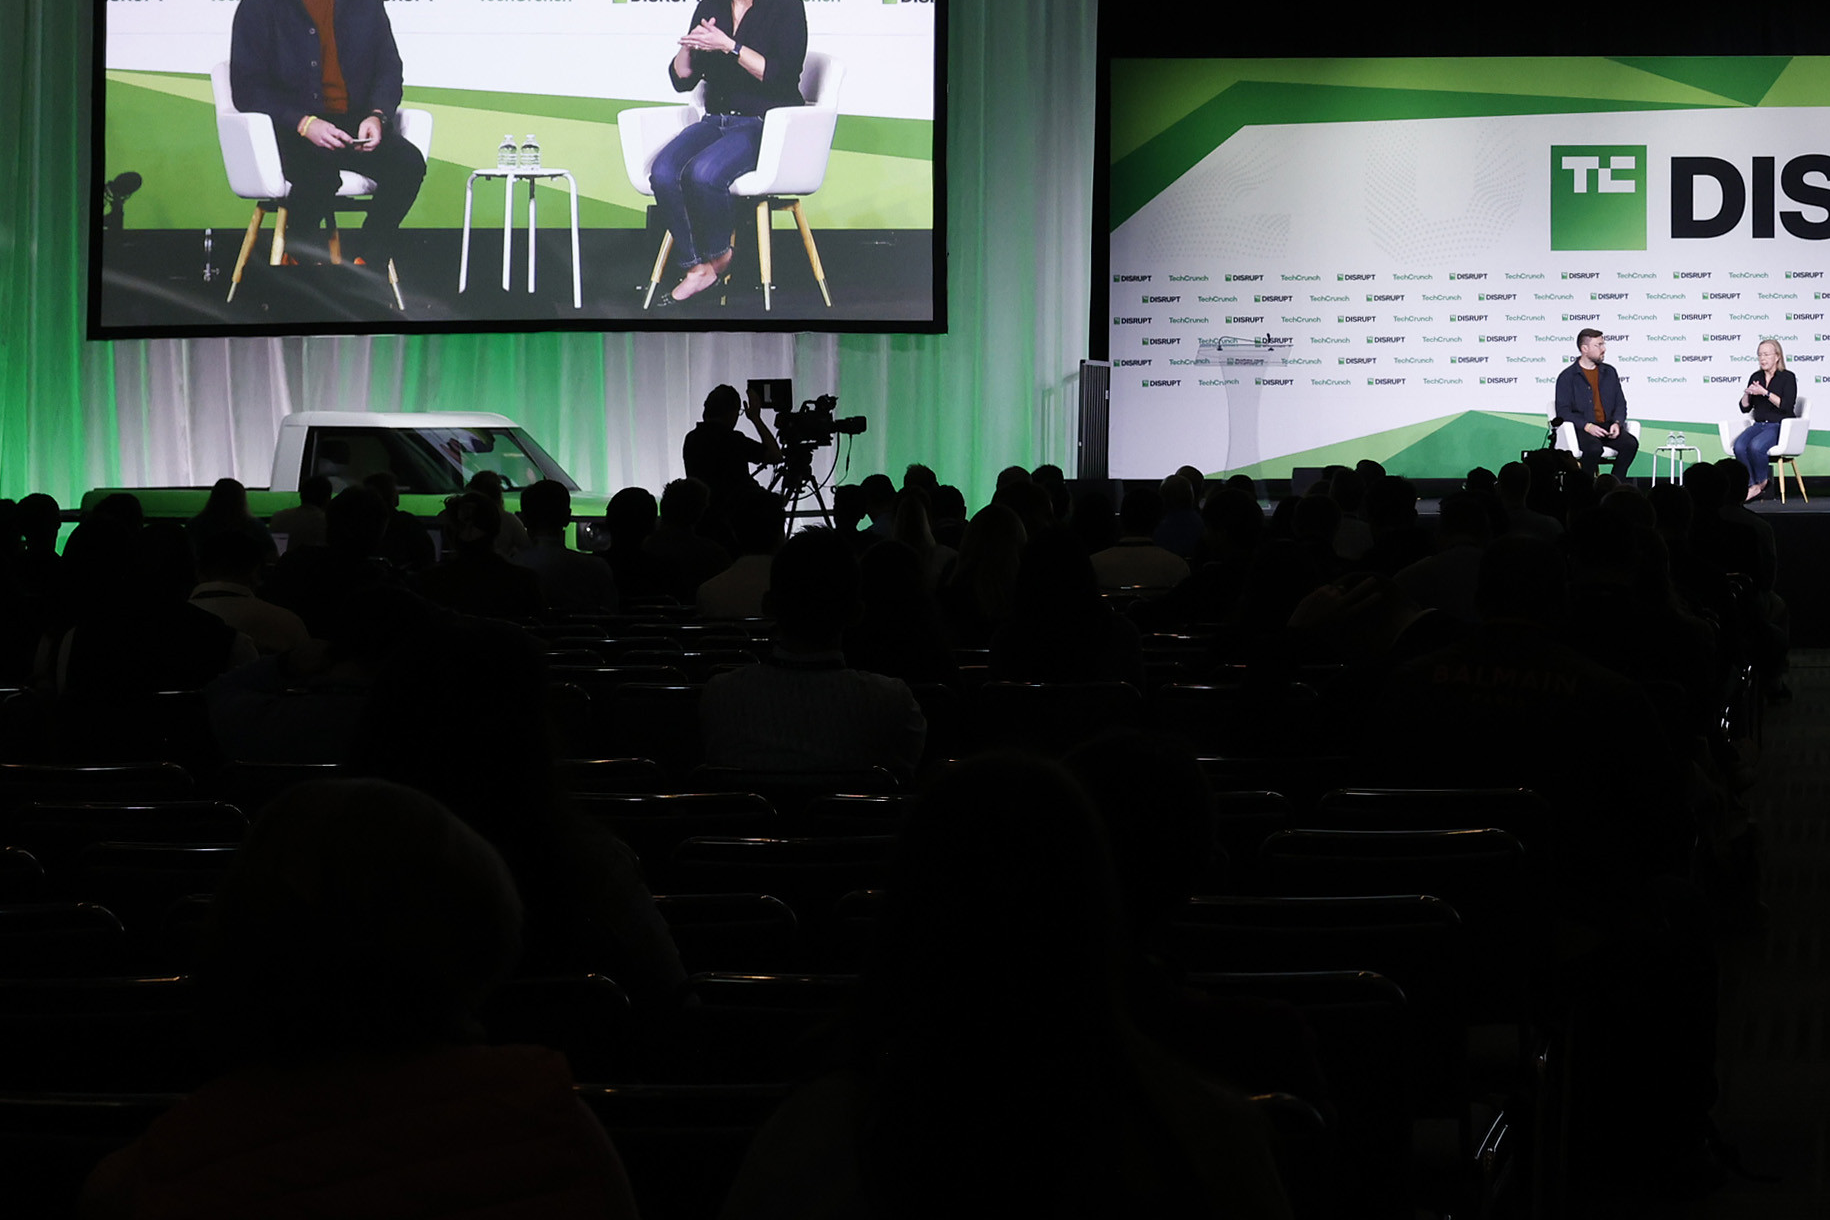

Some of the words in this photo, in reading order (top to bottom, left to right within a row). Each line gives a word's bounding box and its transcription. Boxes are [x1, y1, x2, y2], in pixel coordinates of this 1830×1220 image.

[1561, 156, 1636, 193] TC
[1120, 274, 1152, 282] DISRUPT
[1232, 274, 1265, 282] DISRUPT
[1281, 274, 1322, 282] TechCrunch
[1505, 272, 1546, 280] TechCrunch
[1617, 271, 1658, 280] TechCrunch
[1729, 271, 1770, 279] TechCrunch
[1261, 295, 1294, 303] DISRUPT
[1310, 294, 1351, 302] TechCrunch
[1485, 293, 1518, 301] DISRUPT
[1534, 293, 1575, 301] TechCrunch
[1646, 292, 1687, 300] TechCrunch
[1709, 292, 1742, 300] DISRUPT
[1120, 316, 1152, 325] DISRUPT
[1232, 316, 1265, 324] DISRUPT
[1281, 315, 1322, 324] TechCrunch
[1505, 314, 1546, 322] TechCrunch
[1617, 313, 1658, 321] TechCrunch
[1681, 313, 1713, 321] DISRUPT
[1729, 313, 1770, 321] TechCrunch
[1310, 336, 1351, 344] TechCrunch
[1486, 335, 1518, 343] DISRUPT
[1120, 359, 1152, 367] DISRUPT
[1394, 356, 1435, 364] TechCrunch
[1149, 380, 1182, 388] DISRUPT
[1311, 378, 1352, 386] TechCrunch
[1423, 377, 1464, 385] TechCrunch
